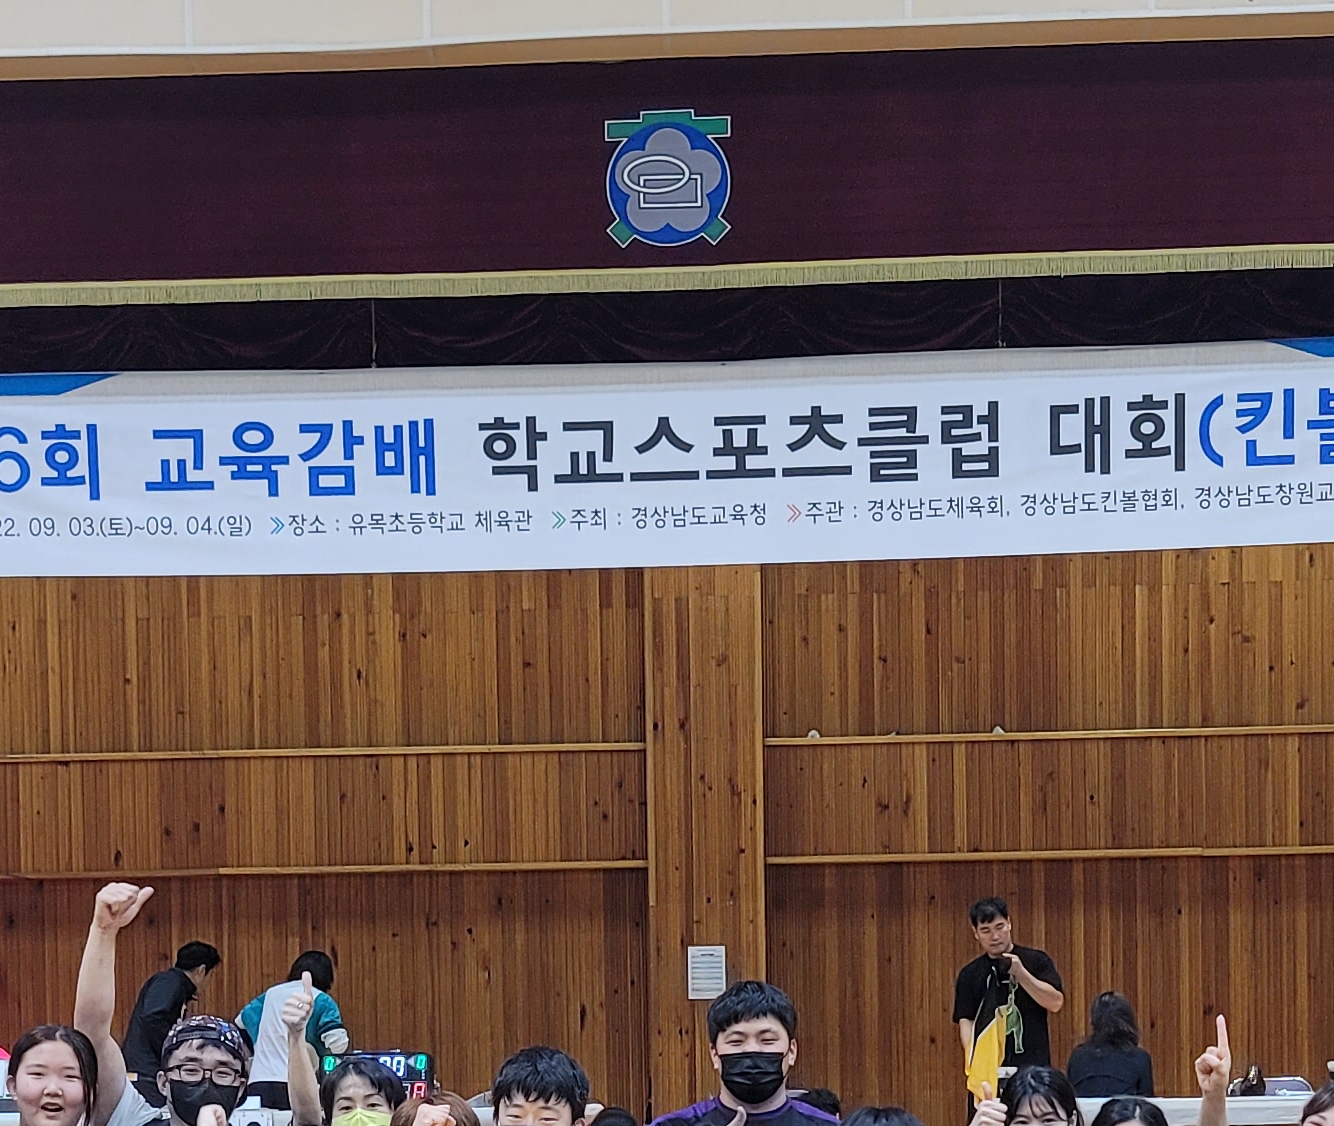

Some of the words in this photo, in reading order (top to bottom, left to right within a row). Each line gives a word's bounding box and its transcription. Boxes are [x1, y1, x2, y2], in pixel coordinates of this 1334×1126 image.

[144, 417, 437, 497] 교육감배
[477, 400, 1000, 493] 학교스포츠클럽
[29, 517, 60, 538] 09.
[186, 514, 252, 538] 04.(일)
[348, 511, 465, 536] 유목초등학교
[474, 508, 533, 533] 체육관
[631, 502, 767, 530] 경상남도교육청
[867, 494, 1010, 522] 경상남도체육회,
[1020, 487, 1185, 517] 경상남도킨볼협회,
